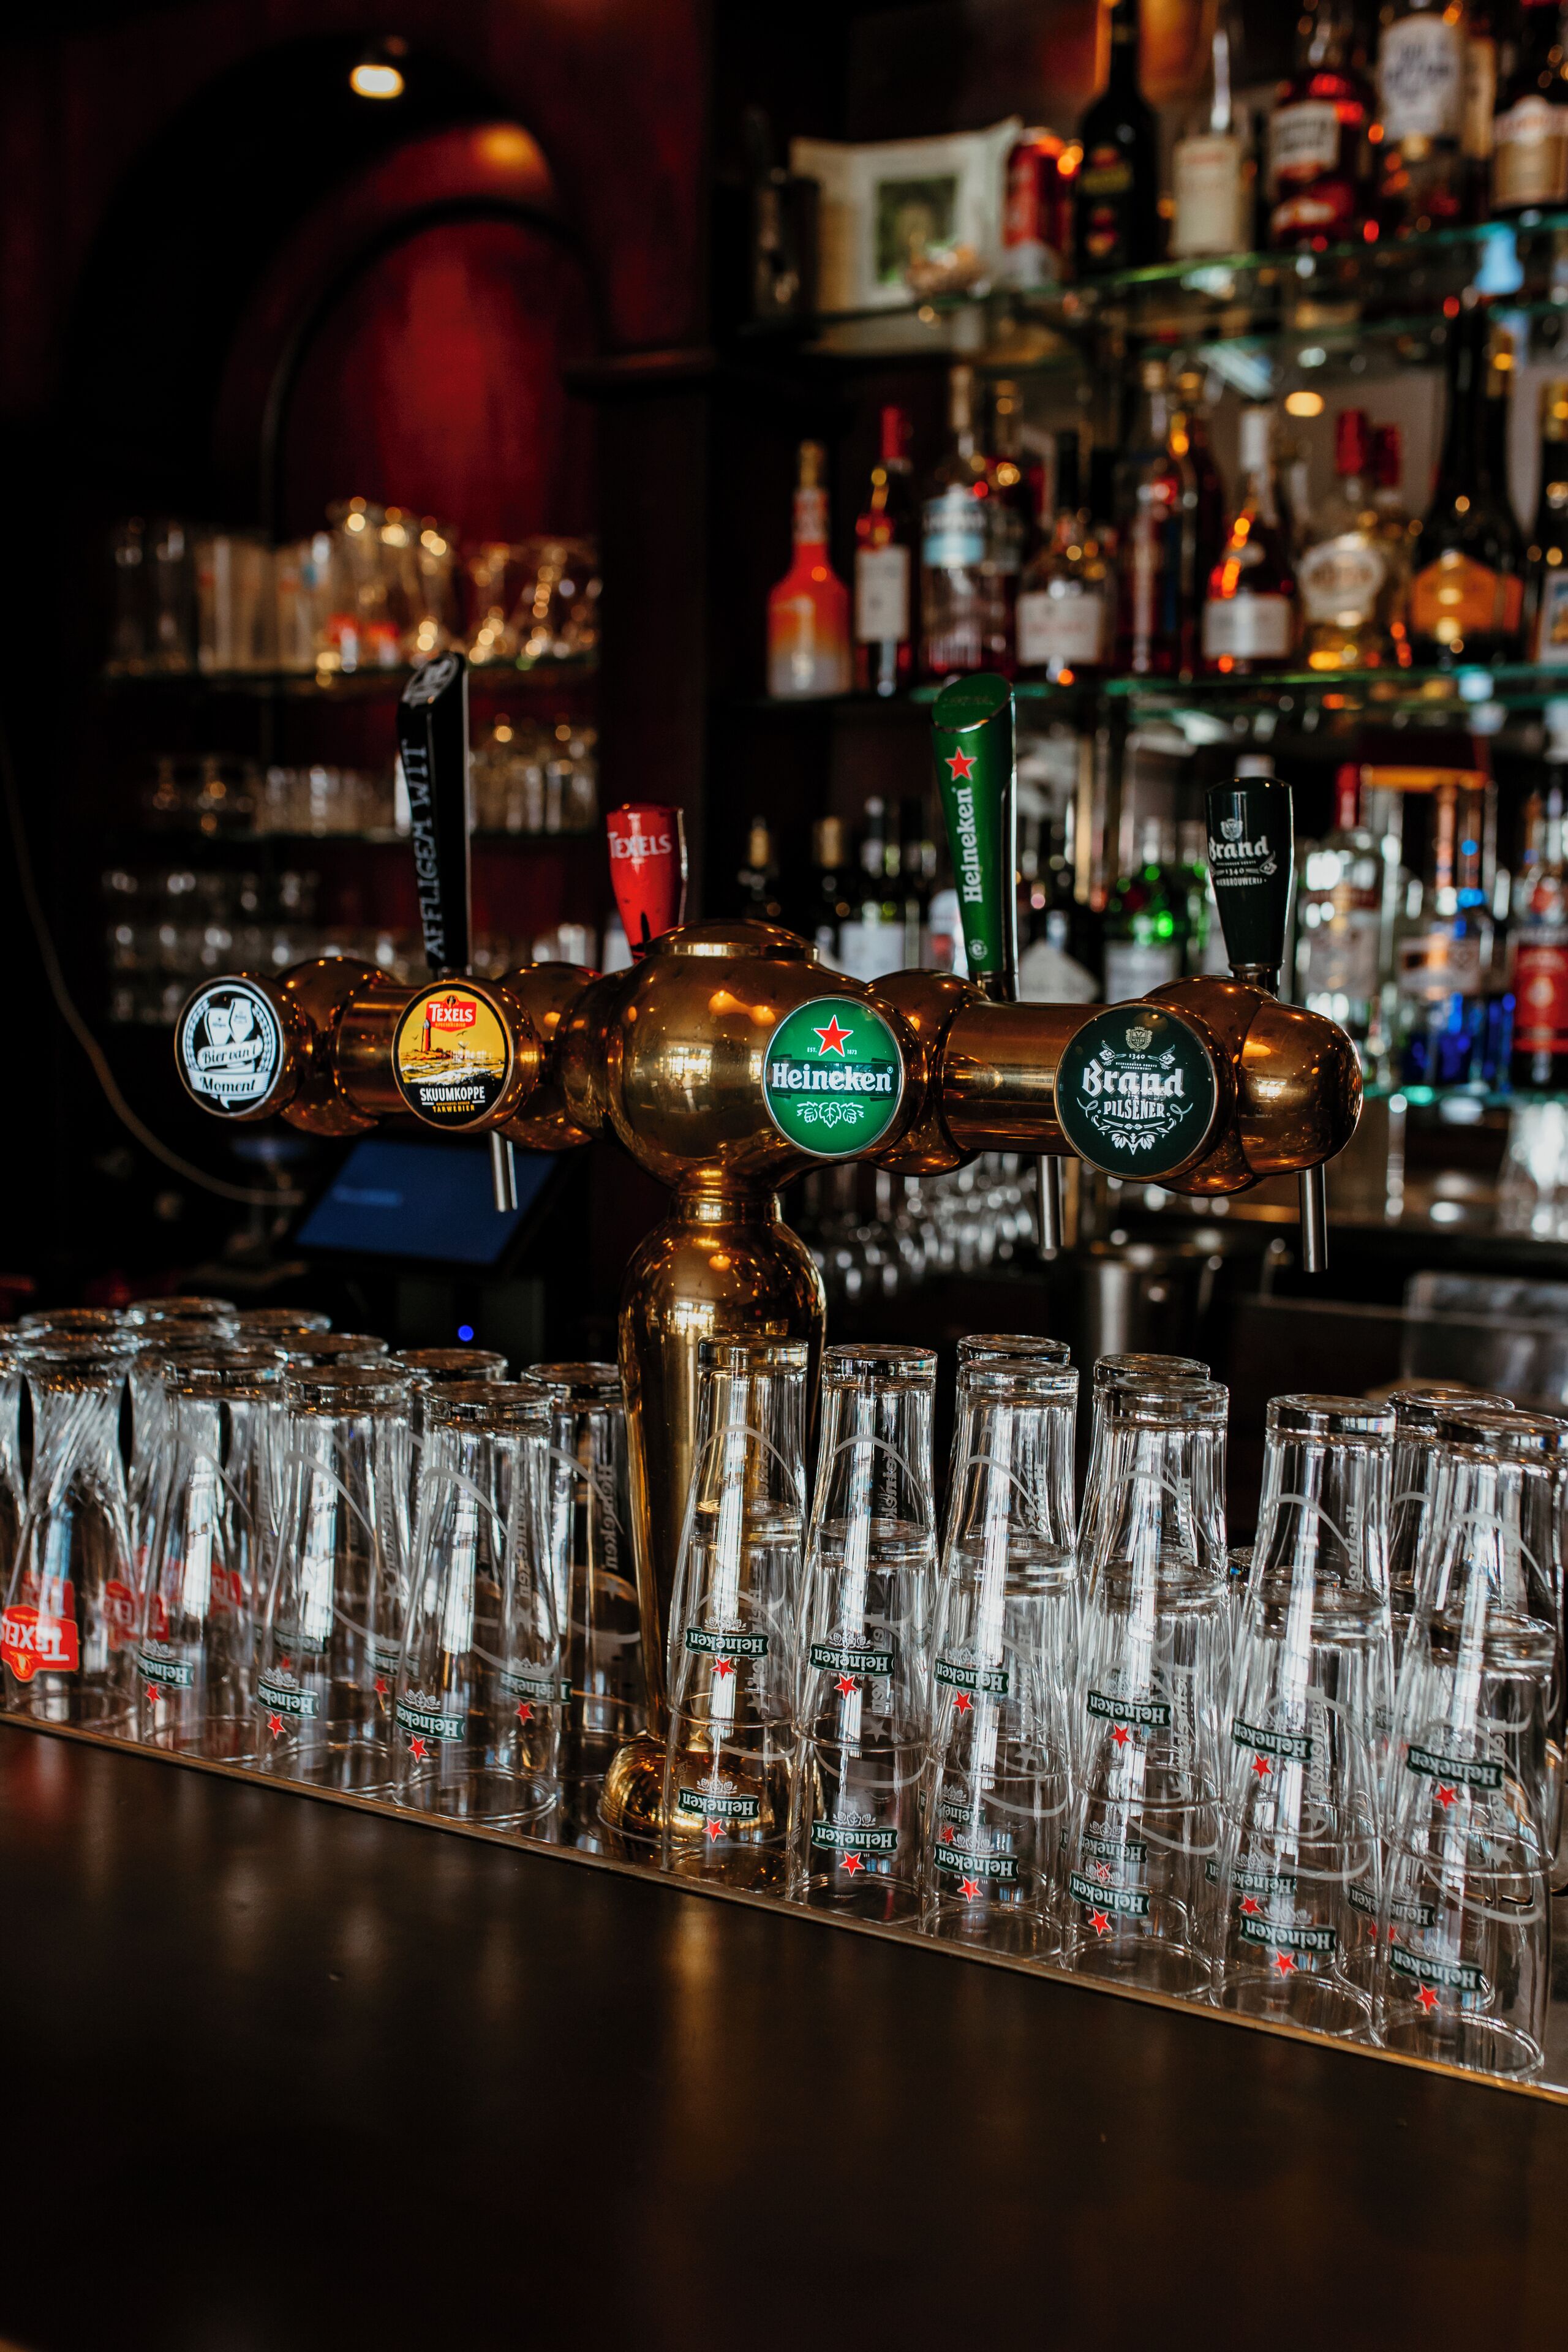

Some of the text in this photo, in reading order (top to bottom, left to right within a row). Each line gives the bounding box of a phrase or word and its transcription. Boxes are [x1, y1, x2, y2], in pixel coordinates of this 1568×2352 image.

[401, 739, 445, 962] AFFLIGEM WIT
[956, 787, 983, 903] Heineken
[1208, 835, 1270, 862] Brand
[429, 1003, 473, 1022] TEXELS
[202, 1049, 227, 1065] Bier
[200, 1076, 255, 1092] Moment
[772, 1063, 892, 1091] Heineken
[1082, 1058, 1185, 1098] Brand
[420, 1086, 485, 1102] SKUUMKOPPE
[432, 1104, 475, 1113] TARWEBIER
[1103, 1099, 1166, 1120] PILSENER
[690, 1632, 764, 1653] Heineken
[814, 1648, 888, 1672] Heineken
[937, 1662, 1004, 1691] Heineken
[1090, 1695, 1165, 1724] Heineken
[1234, 1722, 1308, 1758] Heineken
[1411, 1750, 1497, 1785] Heineken
[683, 1793, 754, 1815] Heineken
[817, 1826, 892, 1849] Heineken
[939, 1848, 1013, 1876] Heineken
[1073, 1878, 1144, 1913] Heineken
[1246, 1919, 1330, 1950] Heineken
[1394, 1949, 1477, 1989] Heineken
